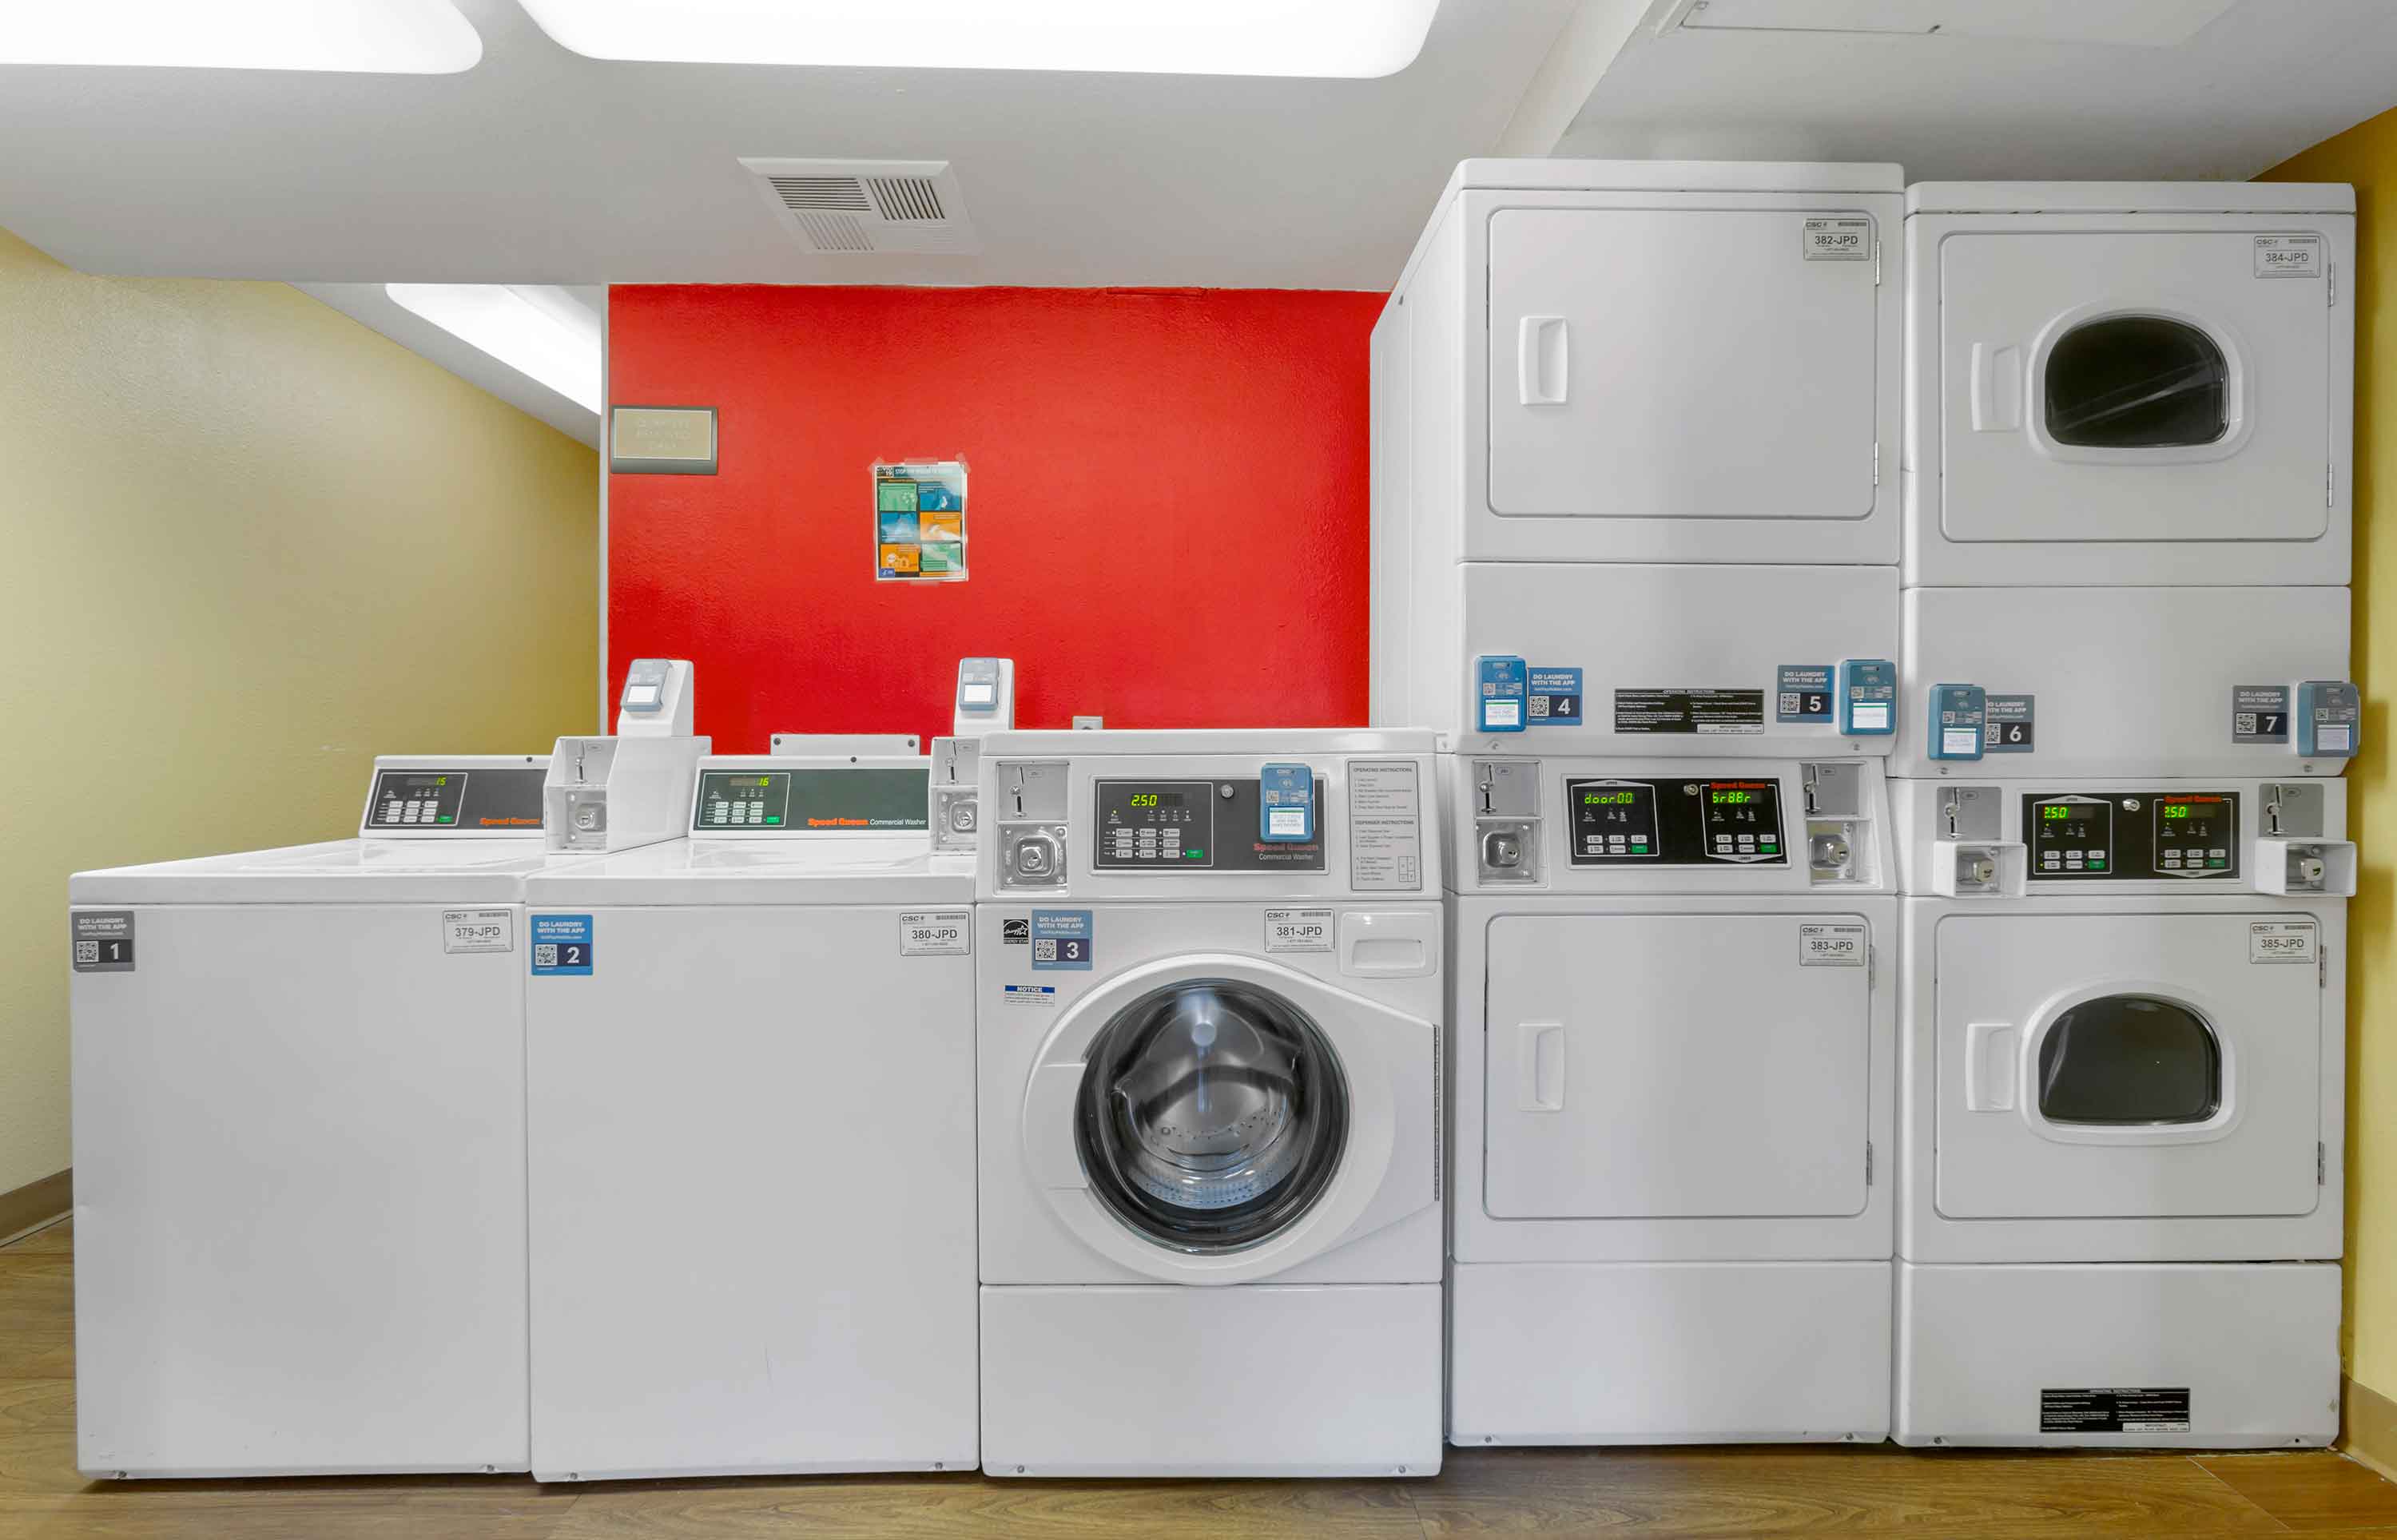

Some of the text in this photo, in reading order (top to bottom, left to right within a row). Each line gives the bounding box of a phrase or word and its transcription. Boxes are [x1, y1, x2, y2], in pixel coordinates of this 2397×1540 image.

[1815, 236, 1858, 244] 382-JPD
[2265, 252, 2309, 262] 384-JPD
[1557, 698, 1571, 715] 4
[1809, 696, 1822, 712] 5
[2265, 716, 2278, 732] 7
[2009, 725, 2022, 742] 6
[1131, 794, 1158, 806] 2.50
[455, 927, 501, 937] 379-JPD
[912, 929, 958, 939] 380-JPD
[1276, 926, 1322, 936] 381-JPD
[1811, 941, 1854, 951] 383-JPD
[2261, 939, 2304, 948] 385-JPD
[110, 943, 119, 960] 1
[566, 947, 580, 964] 2
[1067, 942, 1079, 959] 3
